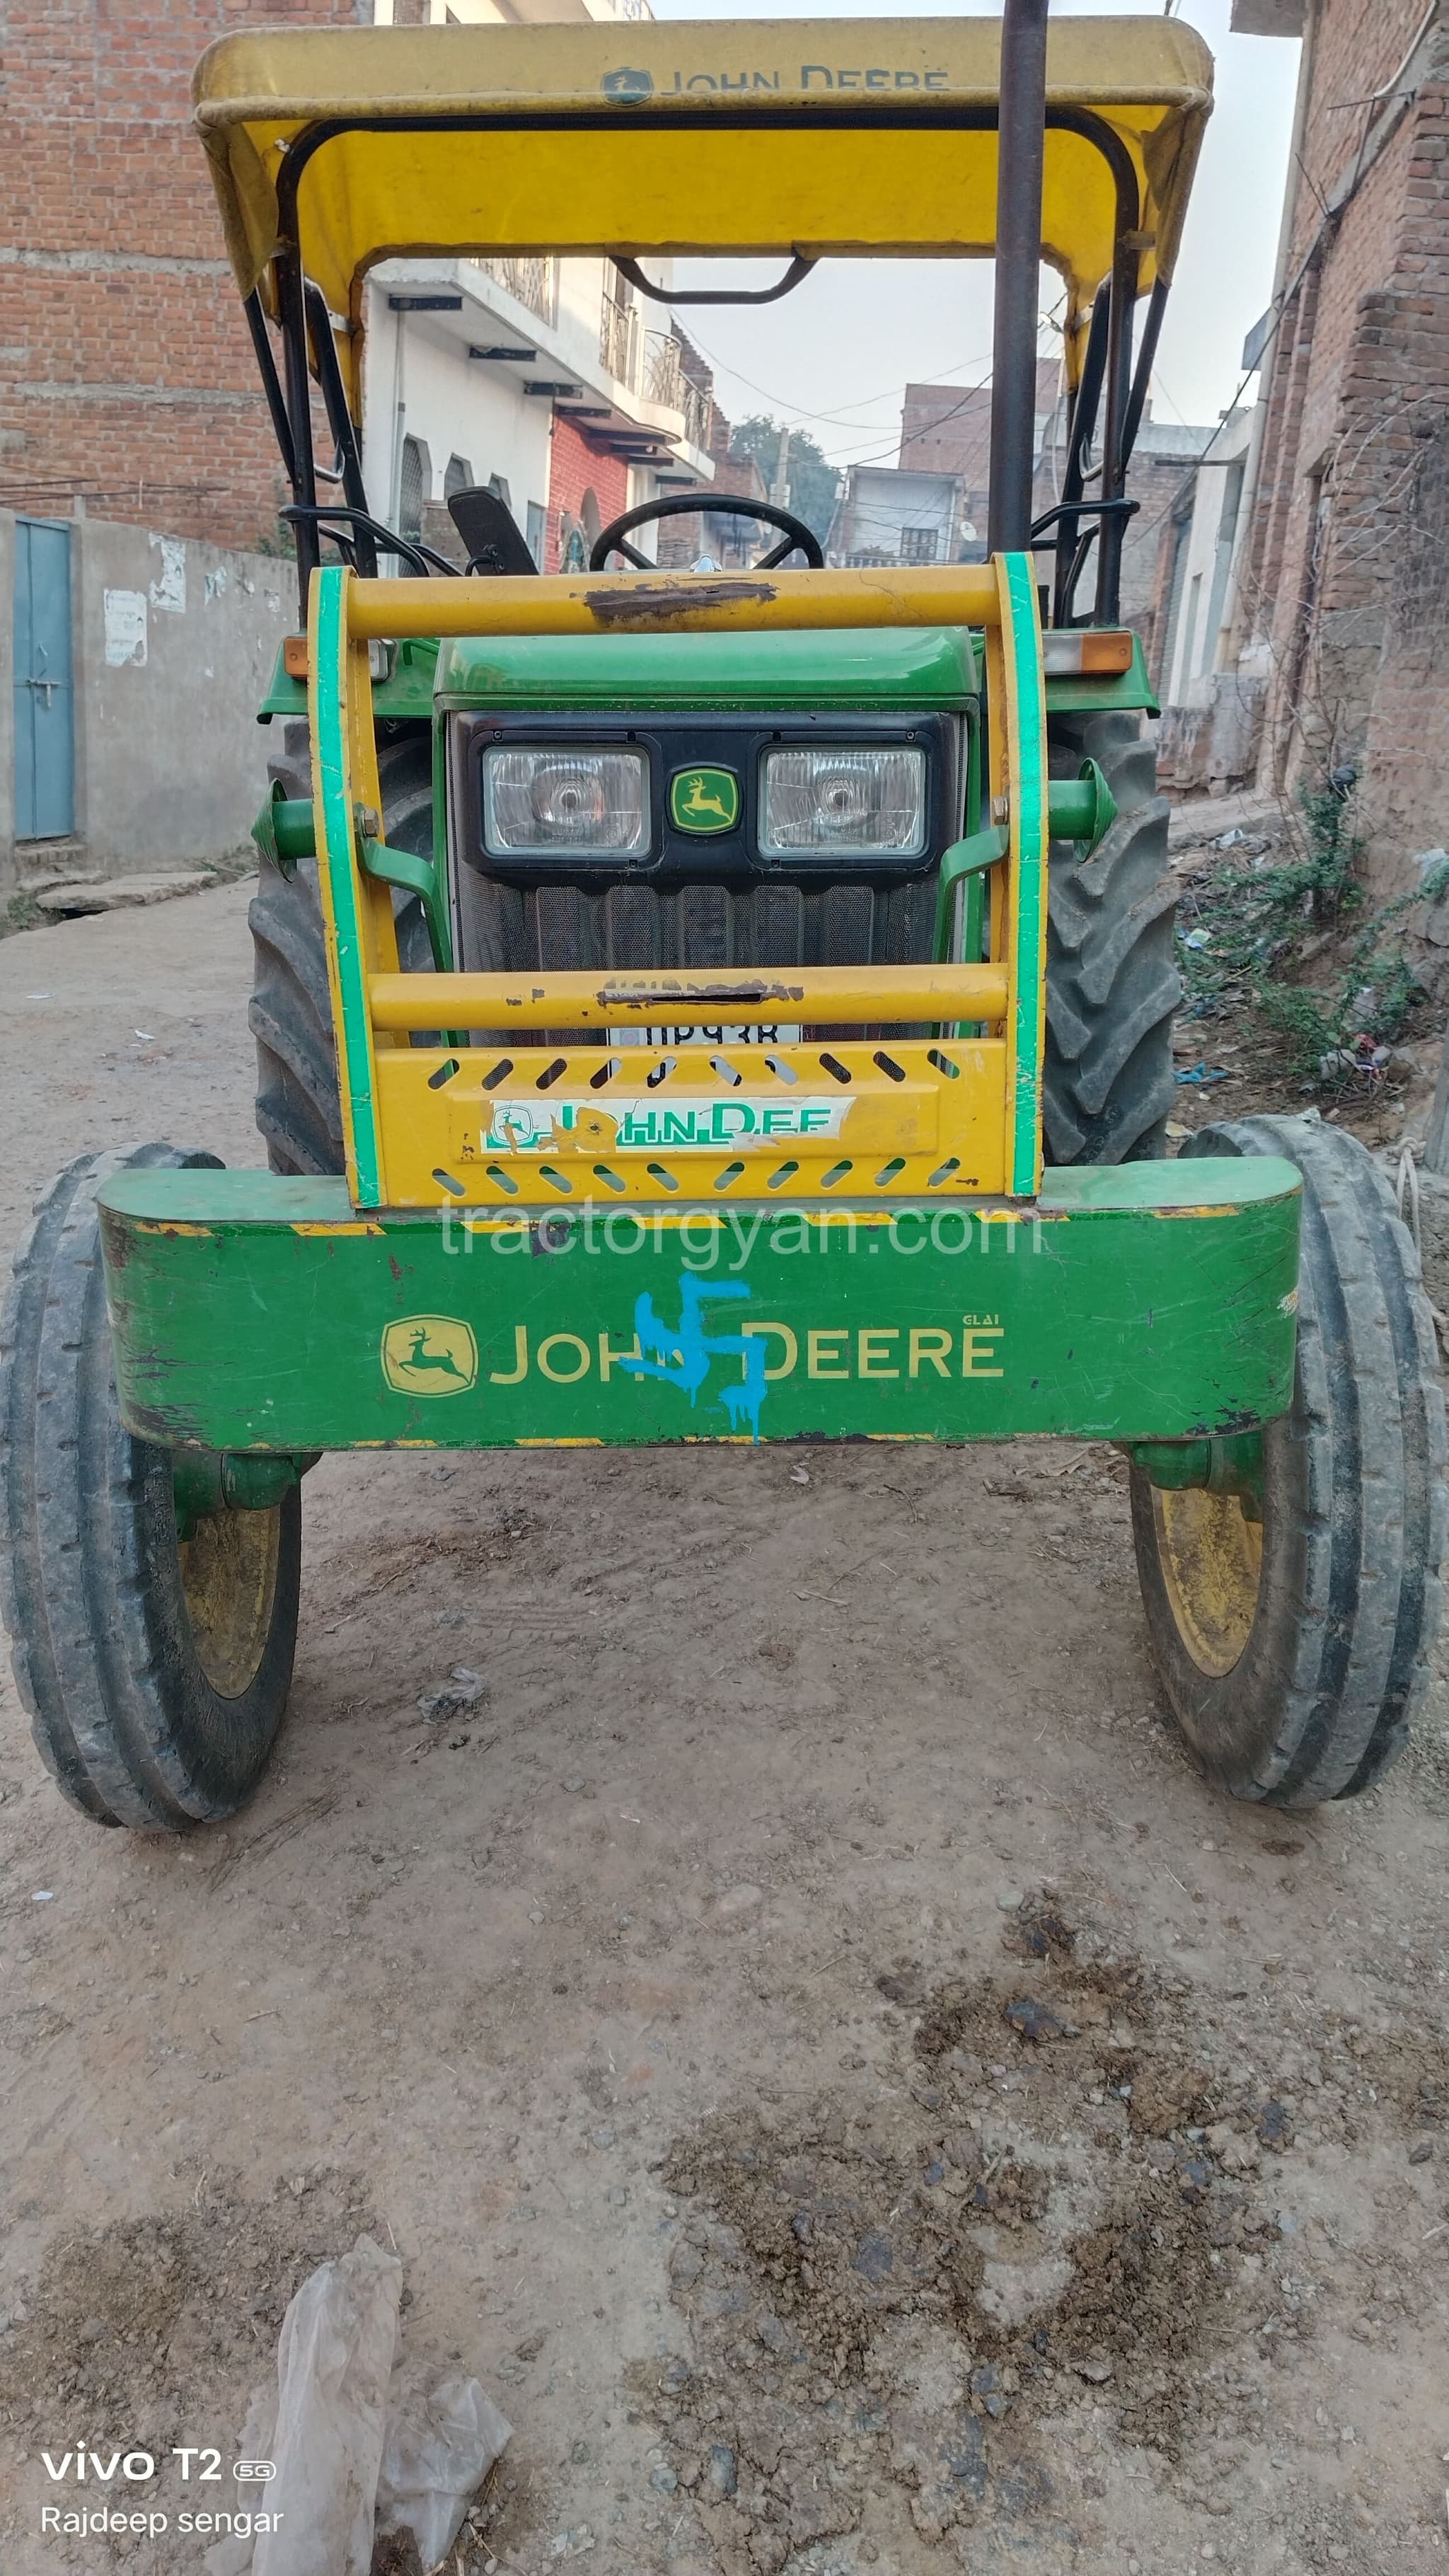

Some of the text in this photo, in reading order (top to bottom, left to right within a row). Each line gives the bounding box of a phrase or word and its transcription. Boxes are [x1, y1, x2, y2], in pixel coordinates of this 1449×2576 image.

[659, 64, 951, 96] JOHN DEERE
[741, 1321, 1004, 1380] DEERE
